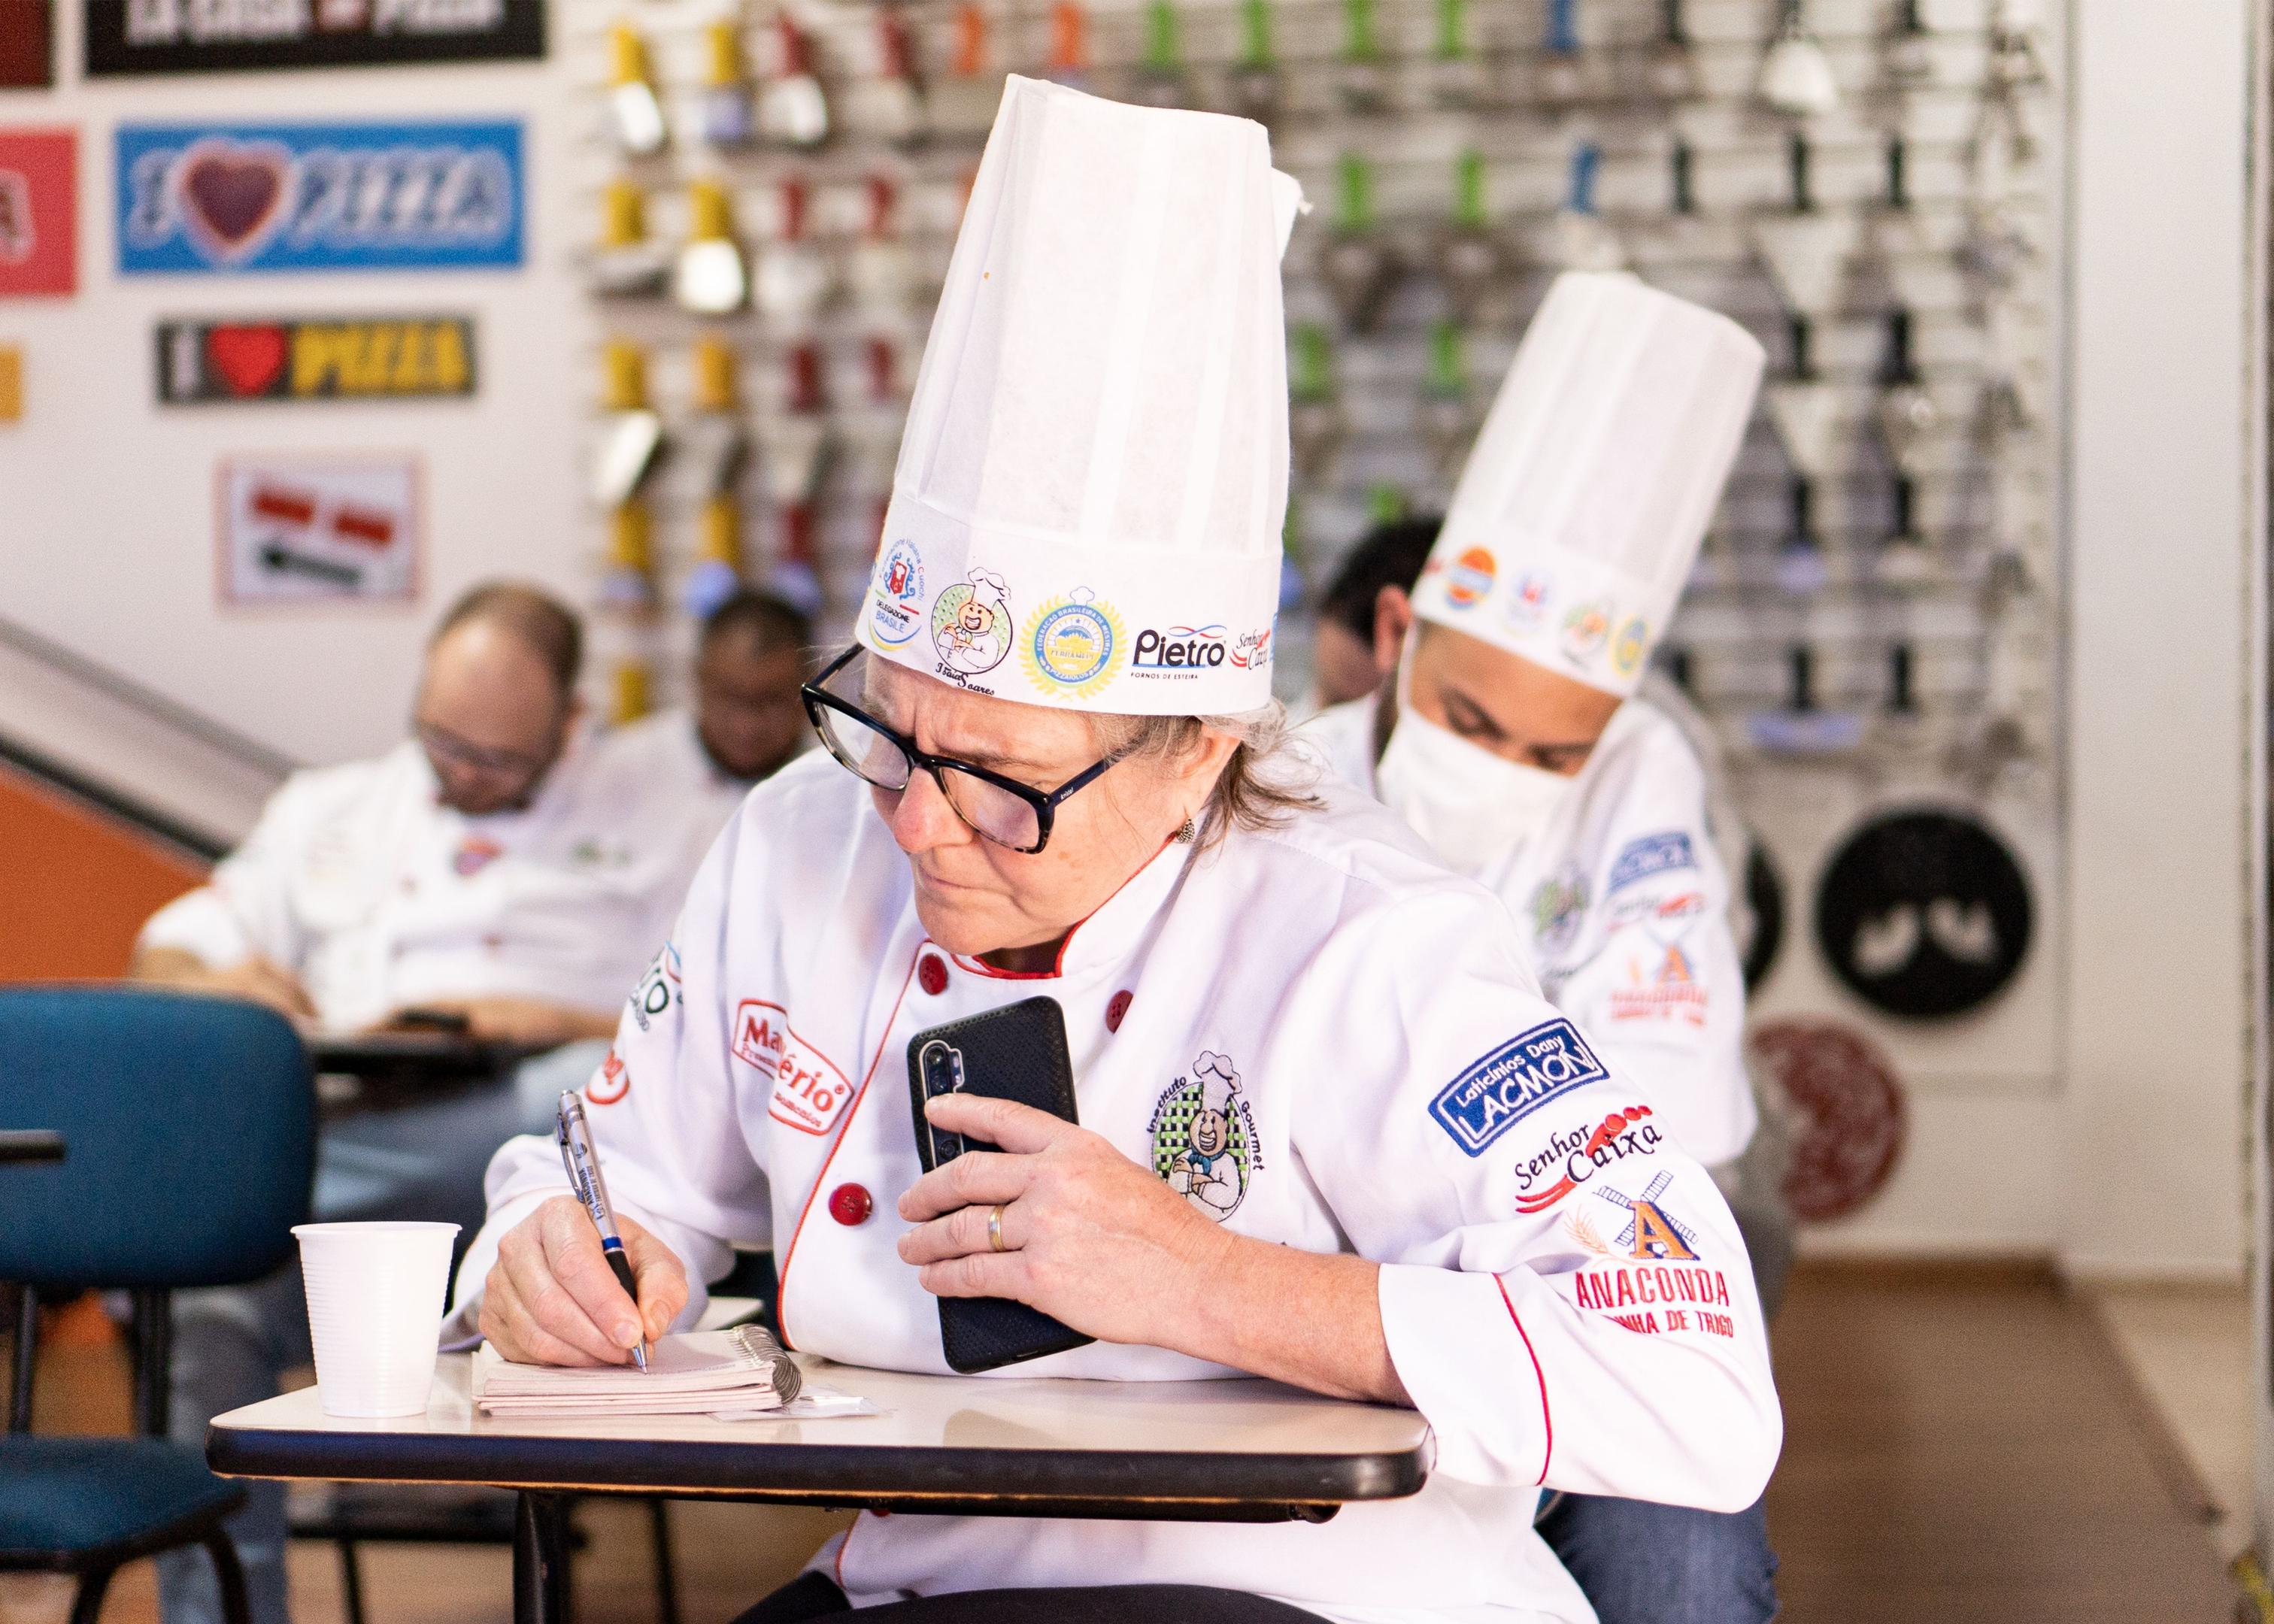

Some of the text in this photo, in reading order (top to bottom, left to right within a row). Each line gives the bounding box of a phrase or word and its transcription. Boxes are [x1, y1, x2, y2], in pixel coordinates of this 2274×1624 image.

[292, 320, 469, 397] PIZZA
[875, 611, 905, 634] BRASILE
[876, 598, 911, 624] DELEGAZIONE
[1133, 629, 1225, 667] Pietro
[1130, 671, 1160, 680] FORNOS
[1526, 1035, 1566, 1058] Dany
[1458, 1045, 1596, 1138] LACMON
[1146, 1076, 1265, 1171] Instituto Gourmet
[1514, 1124, 1590, 1190] Senhor
[1566, 1125, 1663, 1183] Caixa
[1575, 1266, 1730, 1310] ANACONDA
[1666, 1310, 1690, 1332] DE
[1694, 1310, 1734, 1338] TRIGO
